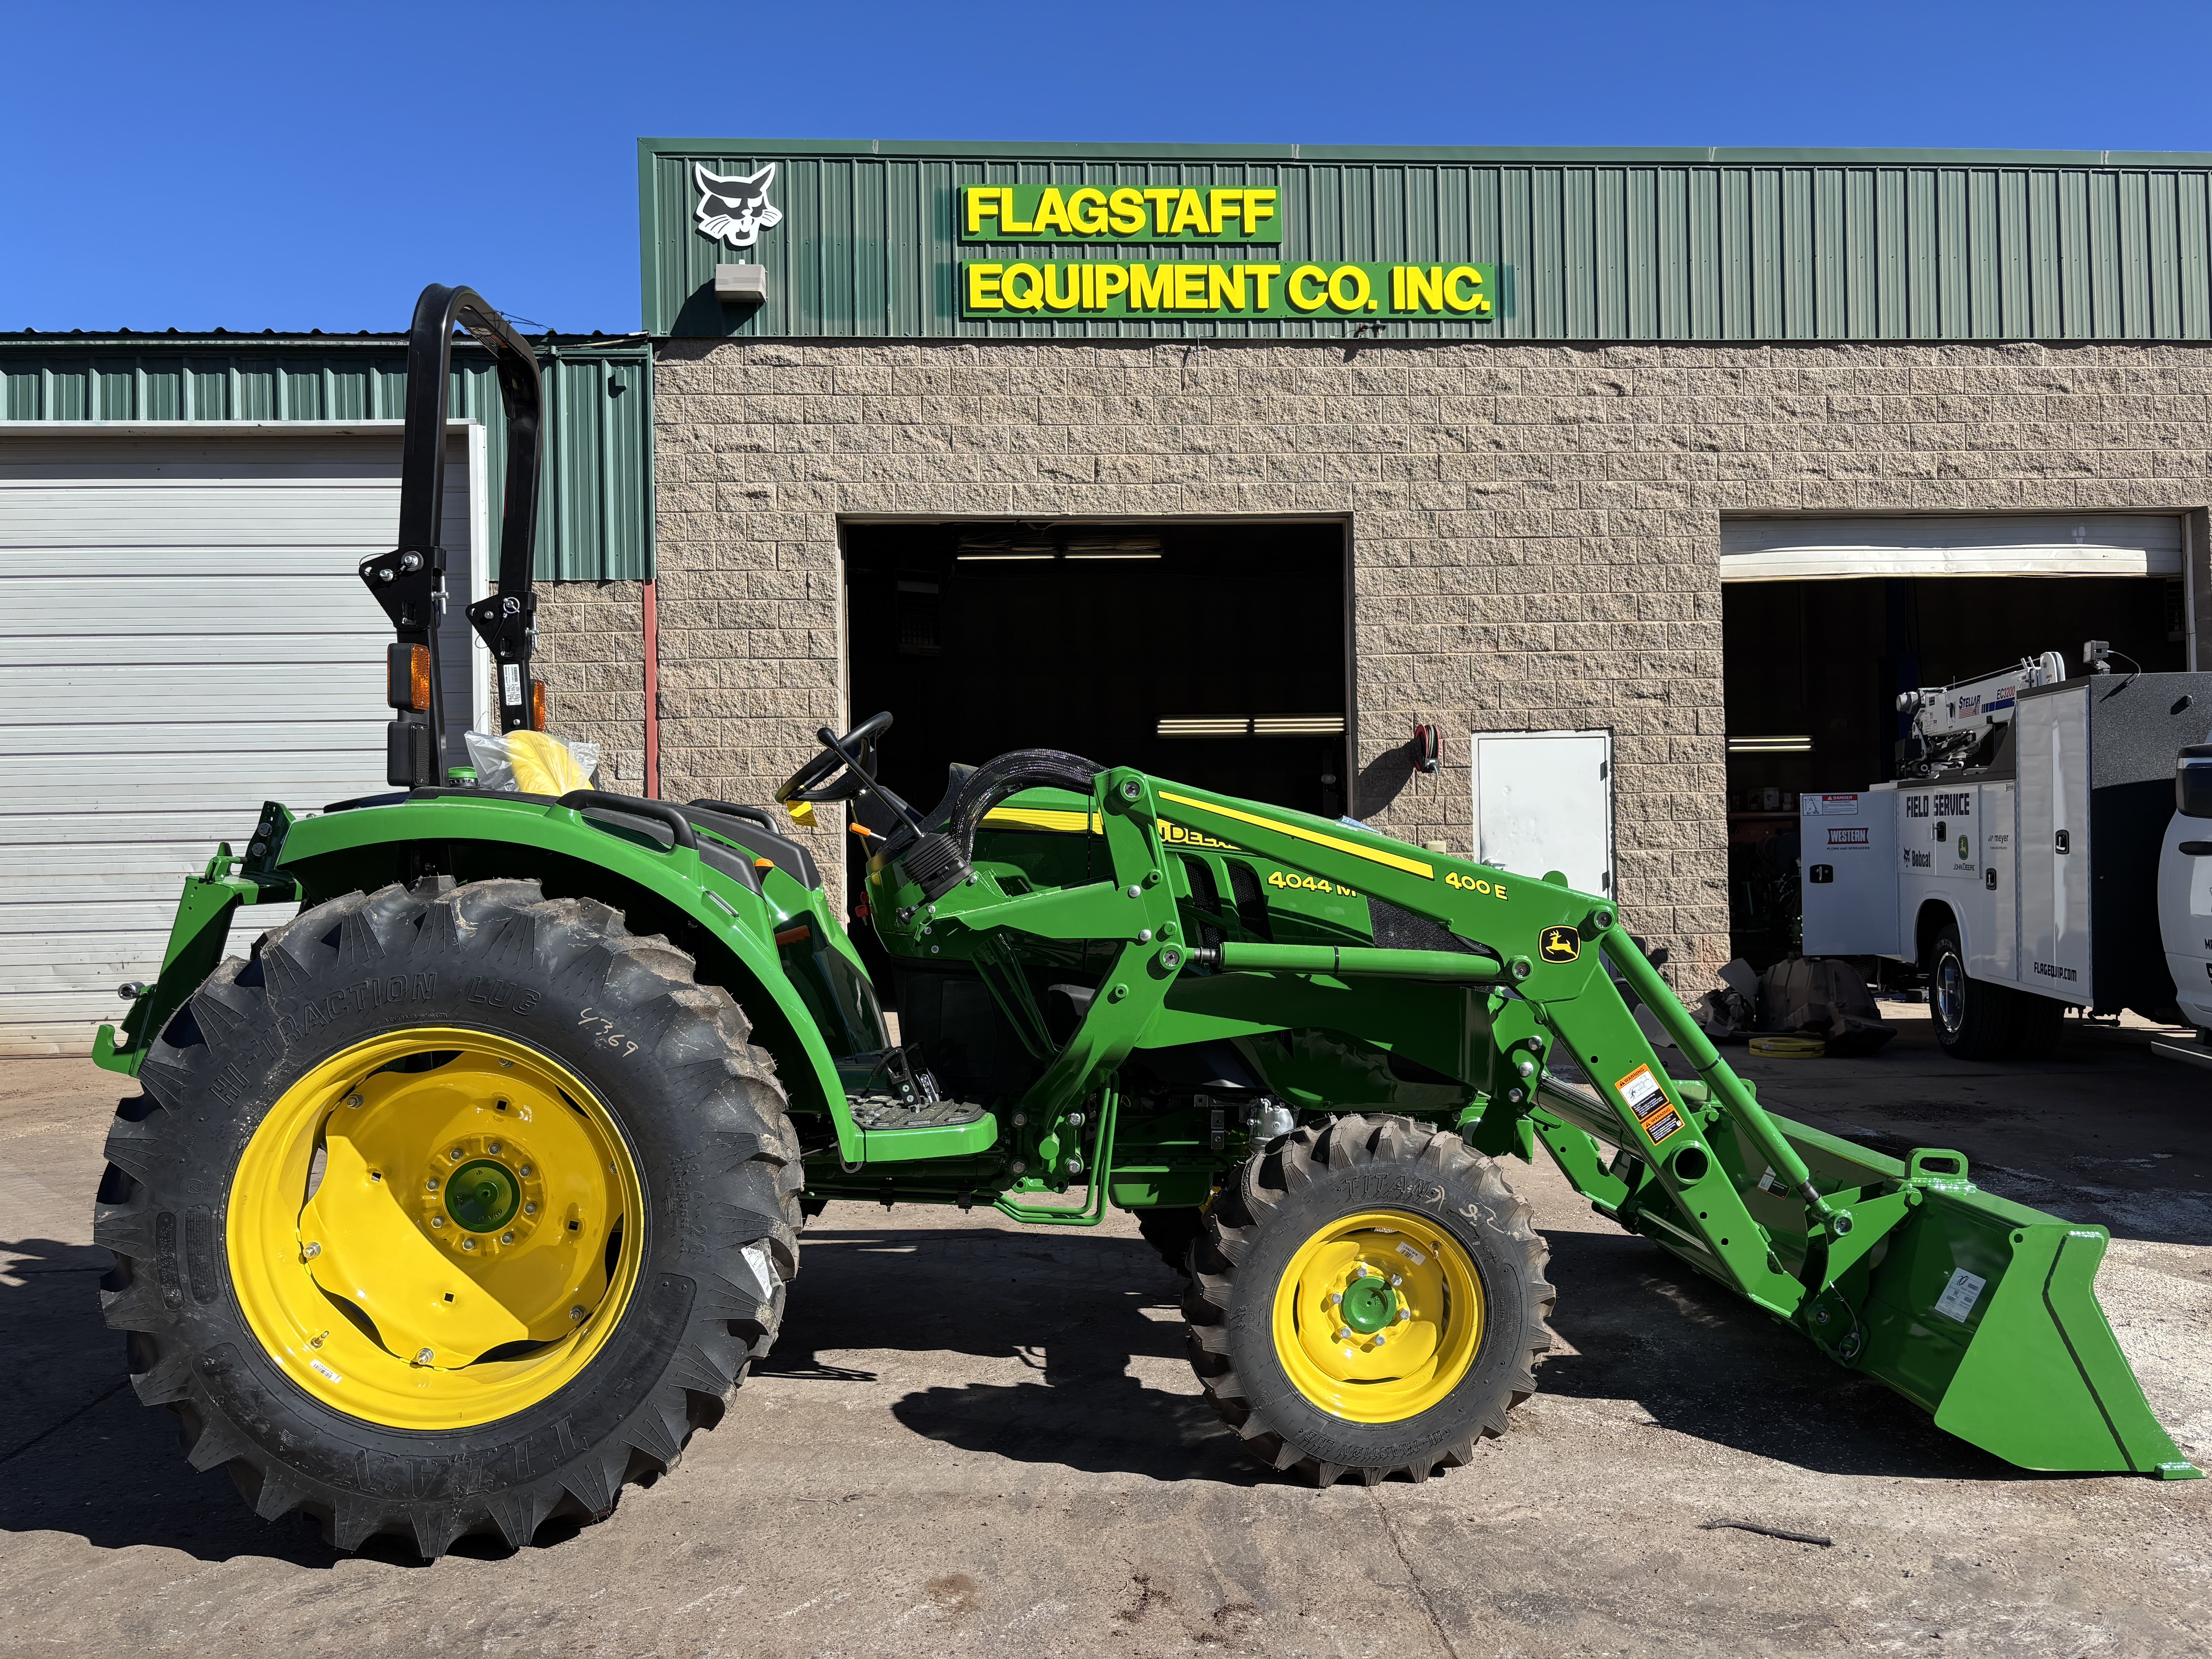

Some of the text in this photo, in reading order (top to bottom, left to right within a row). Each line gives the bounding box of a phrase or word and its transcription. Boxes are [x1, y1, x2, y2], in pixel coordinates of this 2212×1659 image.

[967, 187, 1276, 233] FLAGSTAFF
[969, 263, 1491, 312] EQUIPMENT CO. INC.
[1959, 695, 1980, 709] STELLAR
[1997, 685, 2015, 700] EC3200
[1906, 793, 1970, 818] FIELD SERVICE
[1830, 830, 1866, 842] WESTERN
[1994, 835, 2009, 843] meyer
[1912, 850, 1931, 867] Bobcat
[1963, 863, 1975, 871] DEERE
[1267, 871, 1357, 898] 4044 M
[1444, 871, 1509, 902] 400 E
[2034, 962, 2077, 982] FLAGEQUIP.COM
[208, 972, 542, 1109] HI-TRACTION LUG
[578, 1008, 639, 1058] 4369
[1624, 1067, 1644, 1083] WARNING
[1651, 1108, 1671, 1123] WARNING
[1345, 1173, 1434, 1197] TITAN
